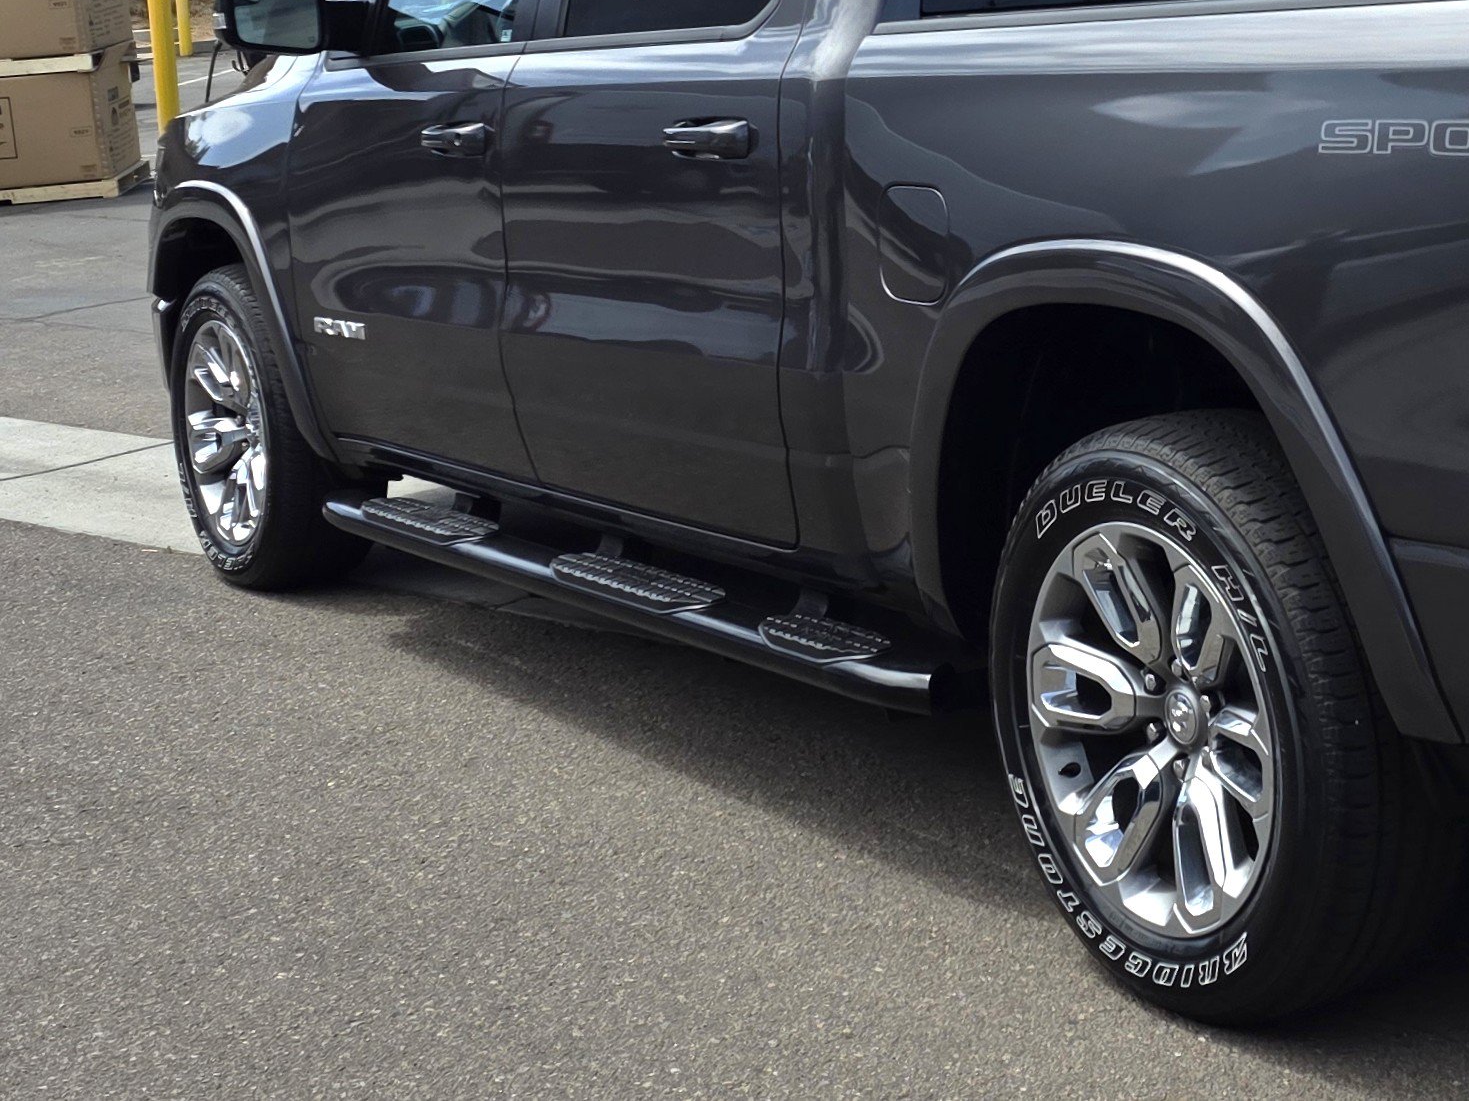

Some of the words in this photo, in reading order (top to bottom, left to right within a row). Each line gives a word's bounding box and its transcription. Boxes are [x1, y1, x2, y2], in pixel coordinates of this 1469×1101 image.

[313, 316, 366, 340] RAM
[1034, 479, 1198, 540] DUELER
[1008, 773, 1248, 988] BRIDGESTONE
